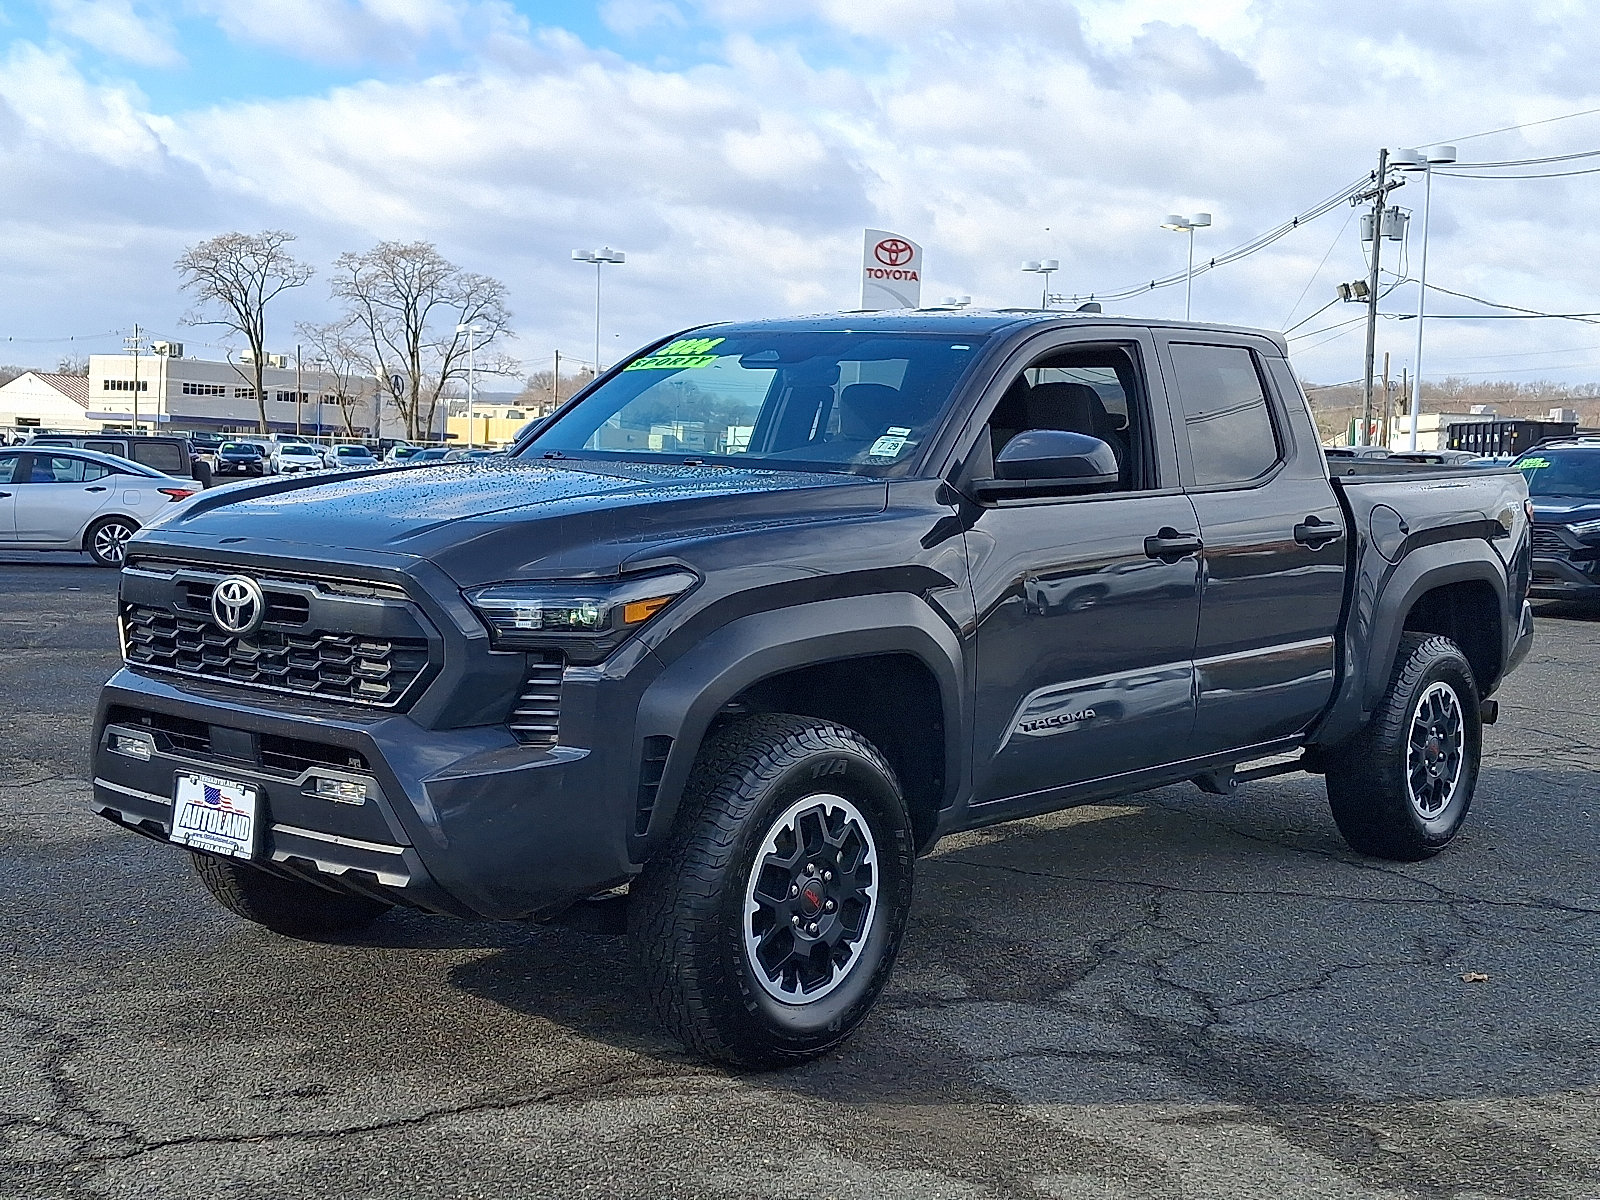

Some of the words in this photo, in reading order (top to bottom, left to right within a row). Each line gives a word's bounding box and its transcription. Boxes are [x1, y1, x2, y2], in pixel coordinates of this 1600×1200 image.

[866, 268, 919, 281] TOYOTA
[630, 356, 713, 368] SPORTY
[878, 441, 886, 450] 7
[888, 442, 900, 451] 29
[1018, 708, 1097, 732] TACOMA
[810, 758, 849, 779] T/A
[179, 803, 251, 842] AUTOLAND
[187, 839, 234, 856] AUTOLAND
